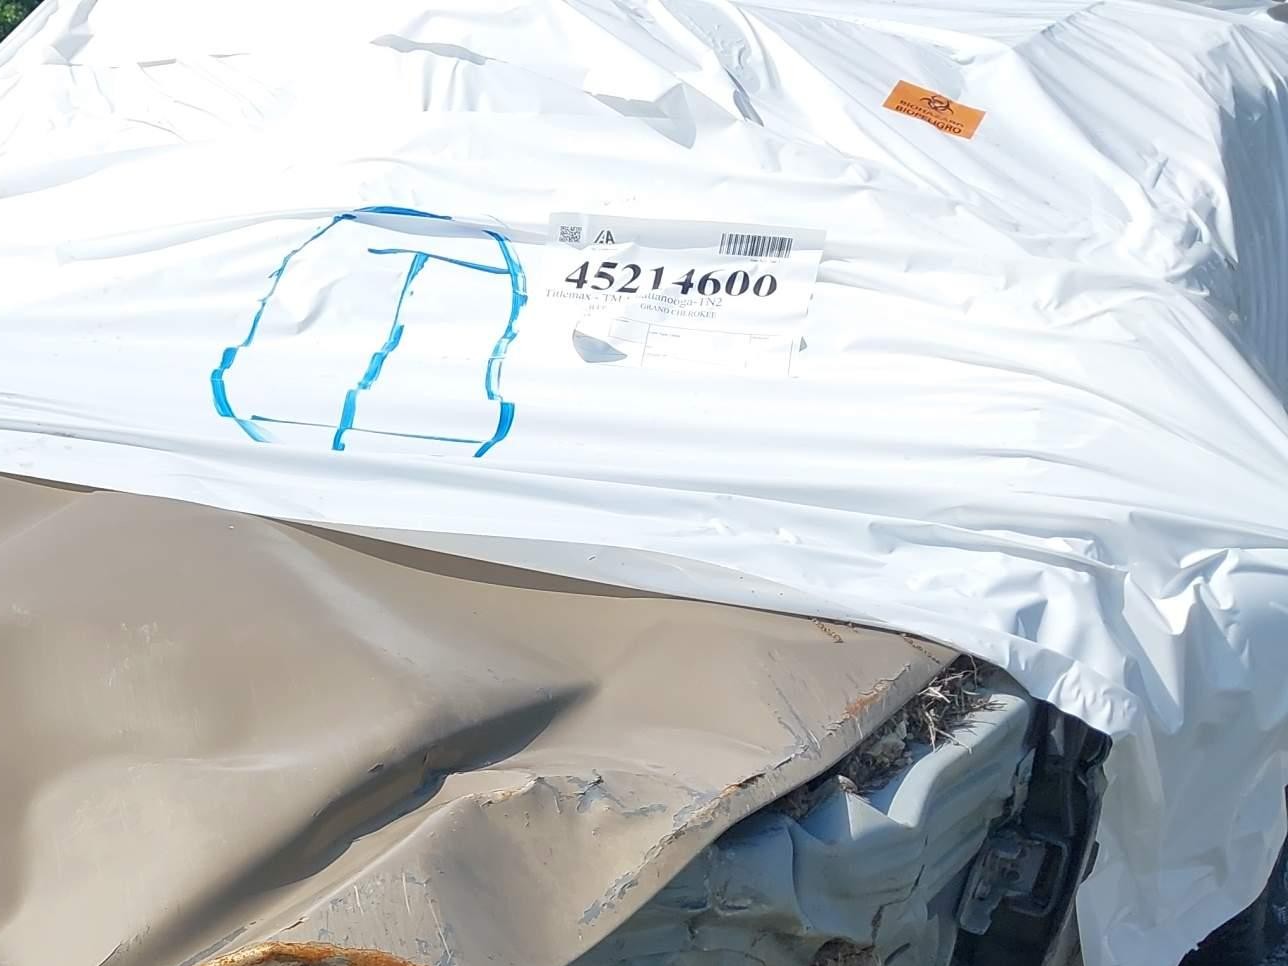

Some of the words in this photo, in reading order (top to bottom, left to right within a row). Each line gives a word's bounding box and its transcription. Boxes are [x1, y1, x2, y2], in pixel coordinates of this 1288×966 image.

[564, 261, 778, 297] 45214600
[544, 288, 592, 301] Titlemax
[640, 303, 670, 314] GRAND
